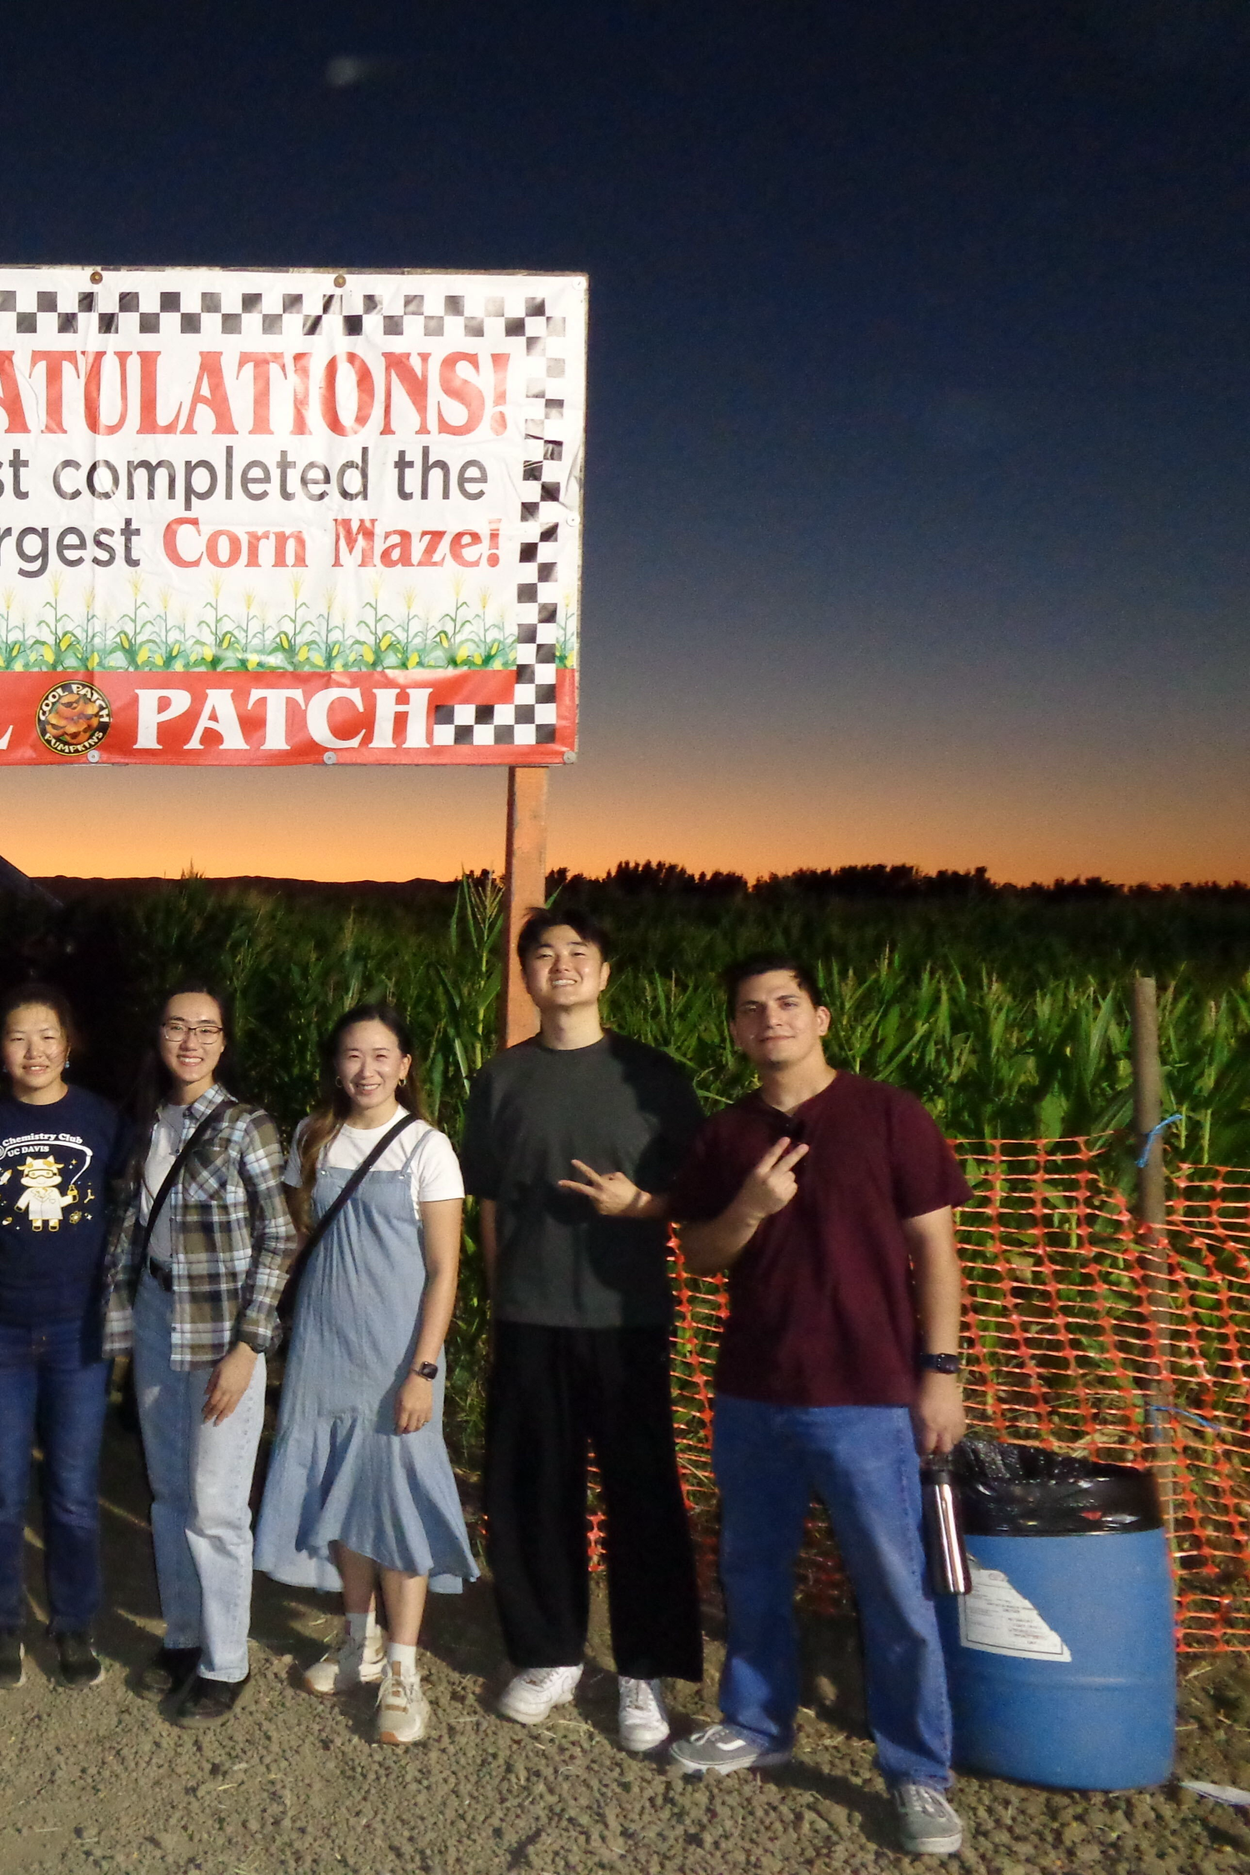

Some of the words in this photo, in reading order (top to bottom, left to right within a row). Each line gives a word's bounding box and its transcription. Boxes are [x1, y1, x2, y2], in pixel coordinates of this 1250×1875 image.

[53, 446, 369, 511] completed
[394, 446, 488, 501] the
[162, 517, 308, 568] Corn
[331, 518, 502, 568] Maze!
[39, 688, 68, 721] COOL
[71, 684, 110, 722] PATCH
[135, 687, 435, 750] PATCH
[44, 731, 103, 753] PUMPKINS
[2, 1133, 57, 1147] Chemistry
[58, 1133, 83, 1144] Club
[7, 1148, 21, 1157] UC
[21, 1146, 50, 1154] DAVIS
